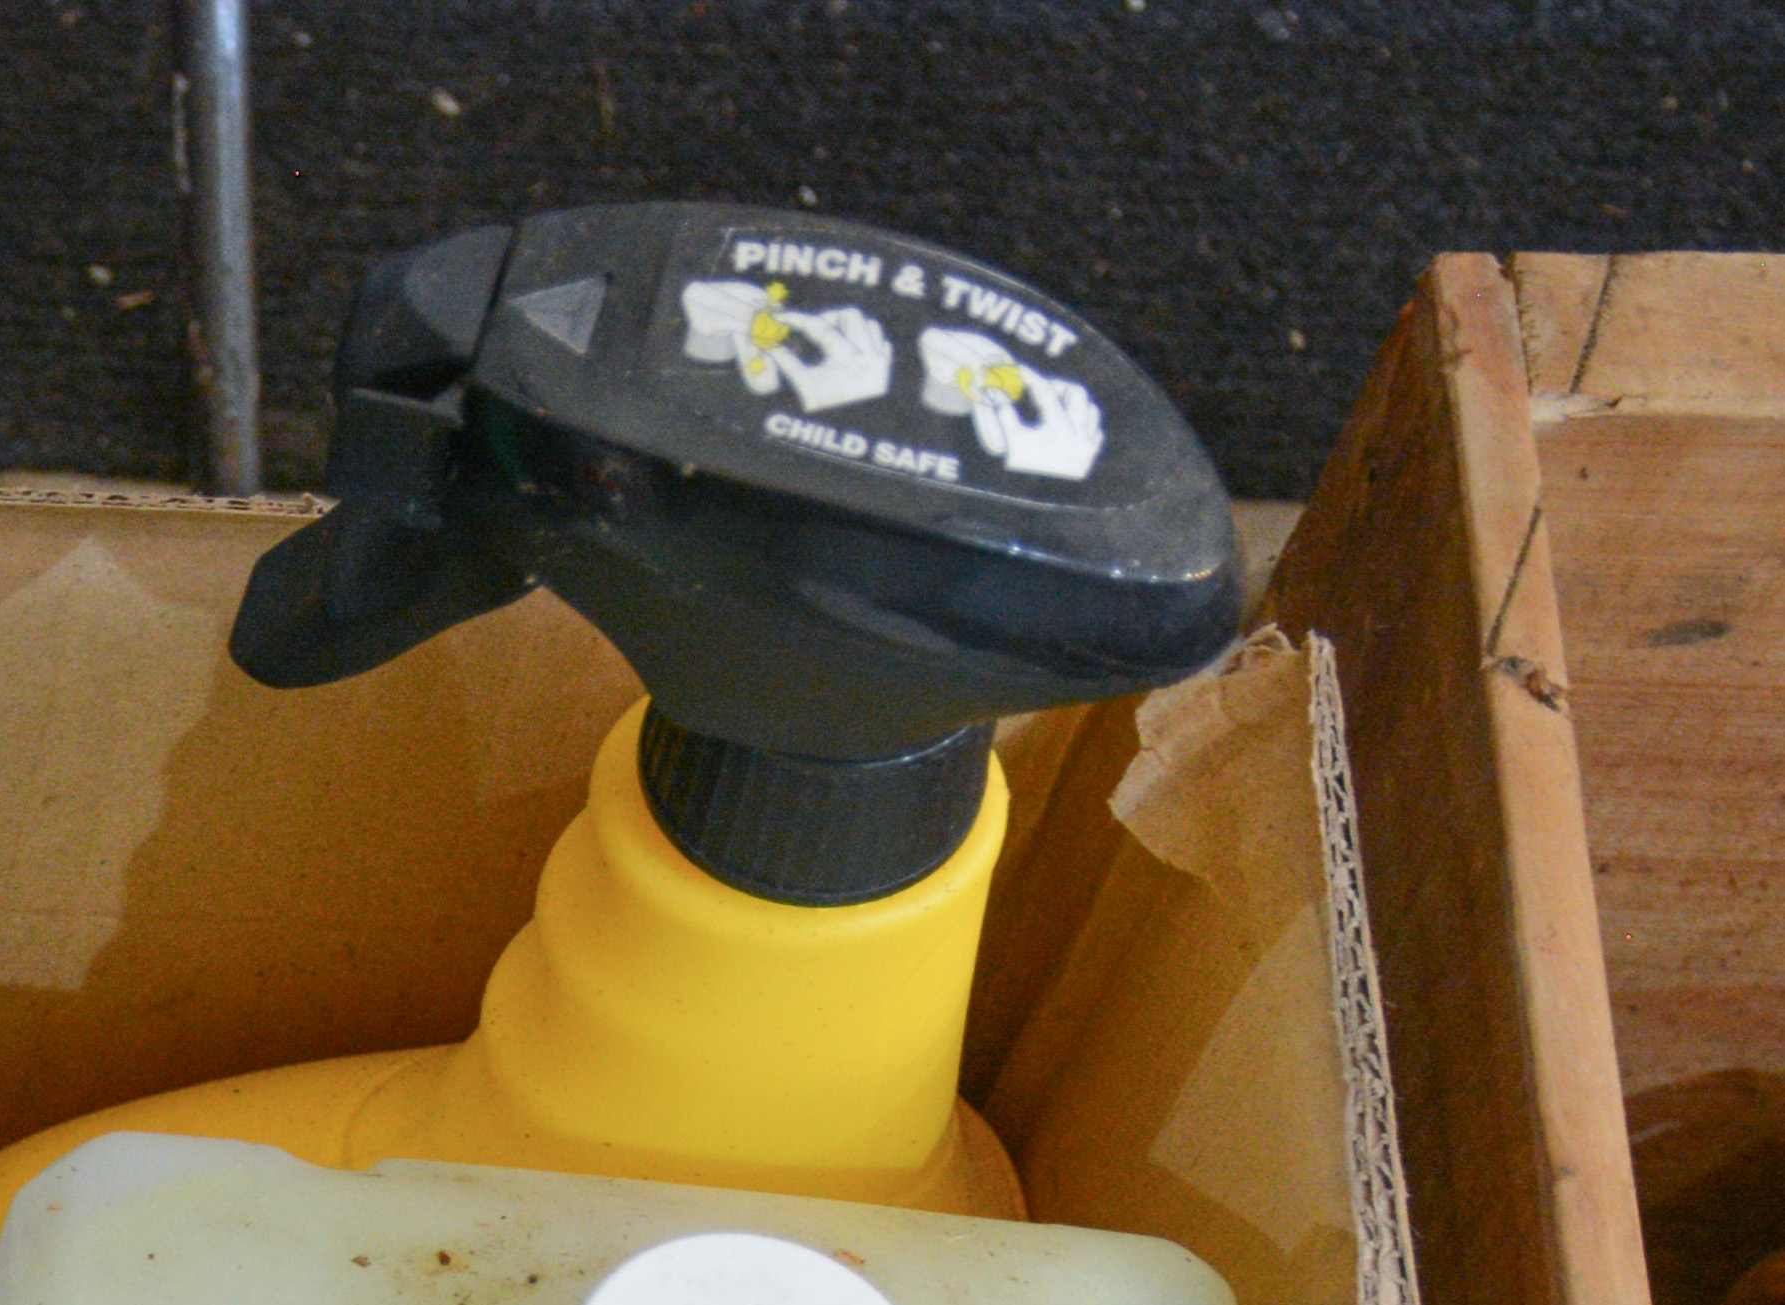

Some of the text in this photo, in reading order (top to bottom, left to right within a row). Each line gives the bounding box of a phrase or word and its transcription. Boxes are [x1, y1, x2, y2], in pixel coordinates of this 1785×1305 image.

[734, 241, 1077, 357] PINCH & TWIST
[764, 413, 960, 482] CHILD SAFE
